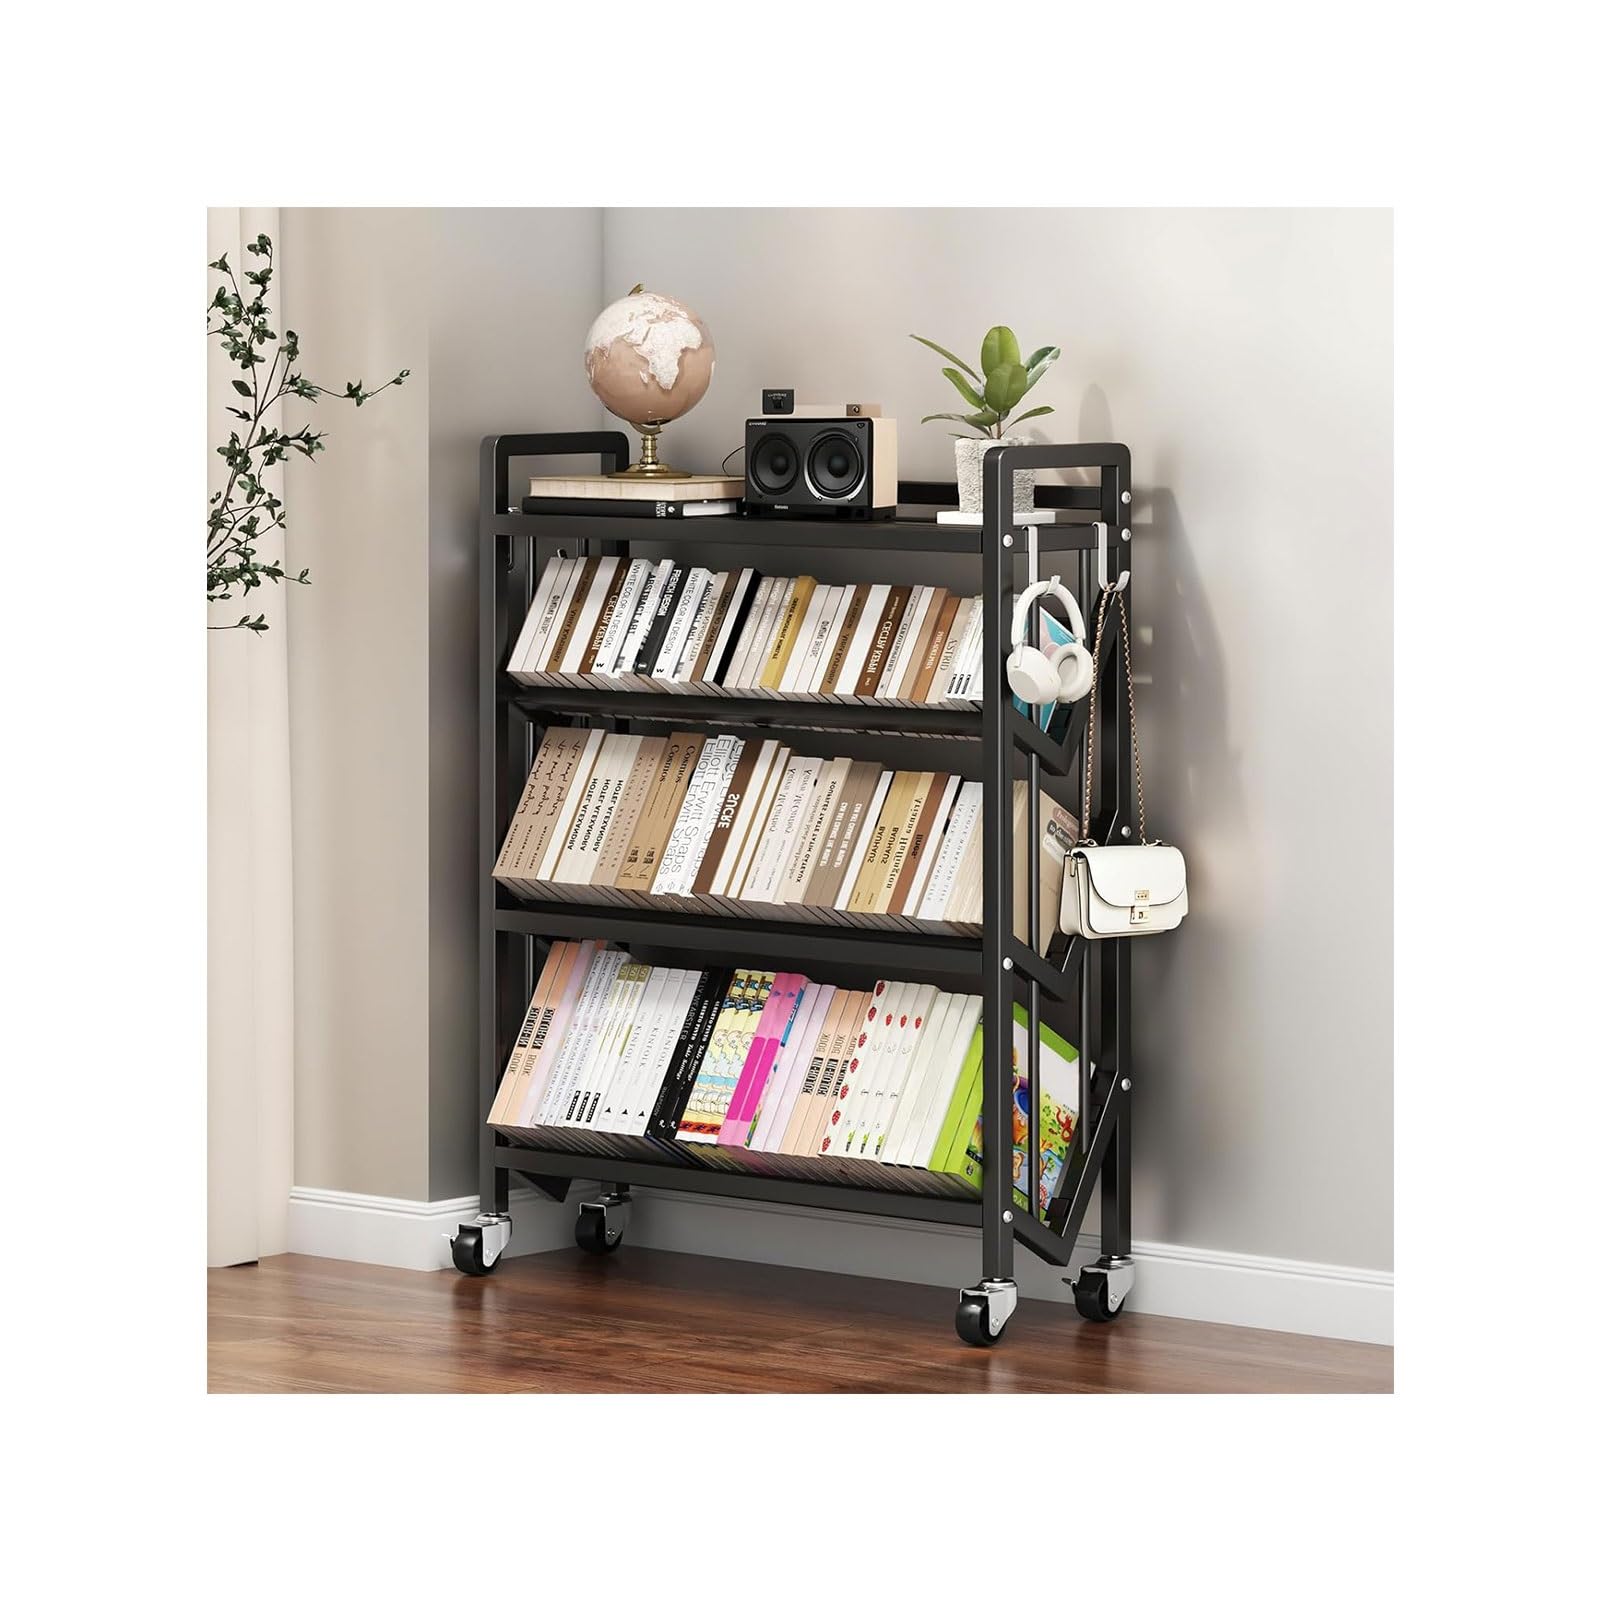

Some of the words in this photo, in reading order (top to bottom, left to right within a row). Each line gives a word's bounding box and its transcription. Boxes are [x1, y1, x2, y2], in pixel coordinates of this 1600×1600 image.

[627, 564, 641, 585] WHITE
[664, 568, 683, 593] FRENCH
[685, 573, 699, 593] WHITE
[620, 586, 633, 608] COLOR
[636, 574, 657, 615] ABSTRACT
[656, 593, 673, 616] DESIGN
[679, 594, 692, 616] COLOR
[604, 620, 620, 648] DESIGN
[628, 618, 639, 634] ART
[664, 626, 680, 654] DESIGN
[696, 742, 714, 778] Elliott
[708, 738, 731, 775] Elliott
[680, 784, 700, 822] Erwitt
[690, 781, 715, 820] Erwitt
[660, 828, 684, 874] Snaps
[671, 826, 699, 872] Snaps
[680, 994, 699, 1040] WEARSTLER
[691, 1024, 700, 1040] PINTO
[702, 1025, 711, 1041] PINTO
[816, 1033, 830, 1052] BOOK
[685, 1044, 693, 1057] Table
[696, 1045, 704, 1059] Table
[831, 1034, 845, 1054] BOOK
[676, 1059, 687, 1080] Settings
